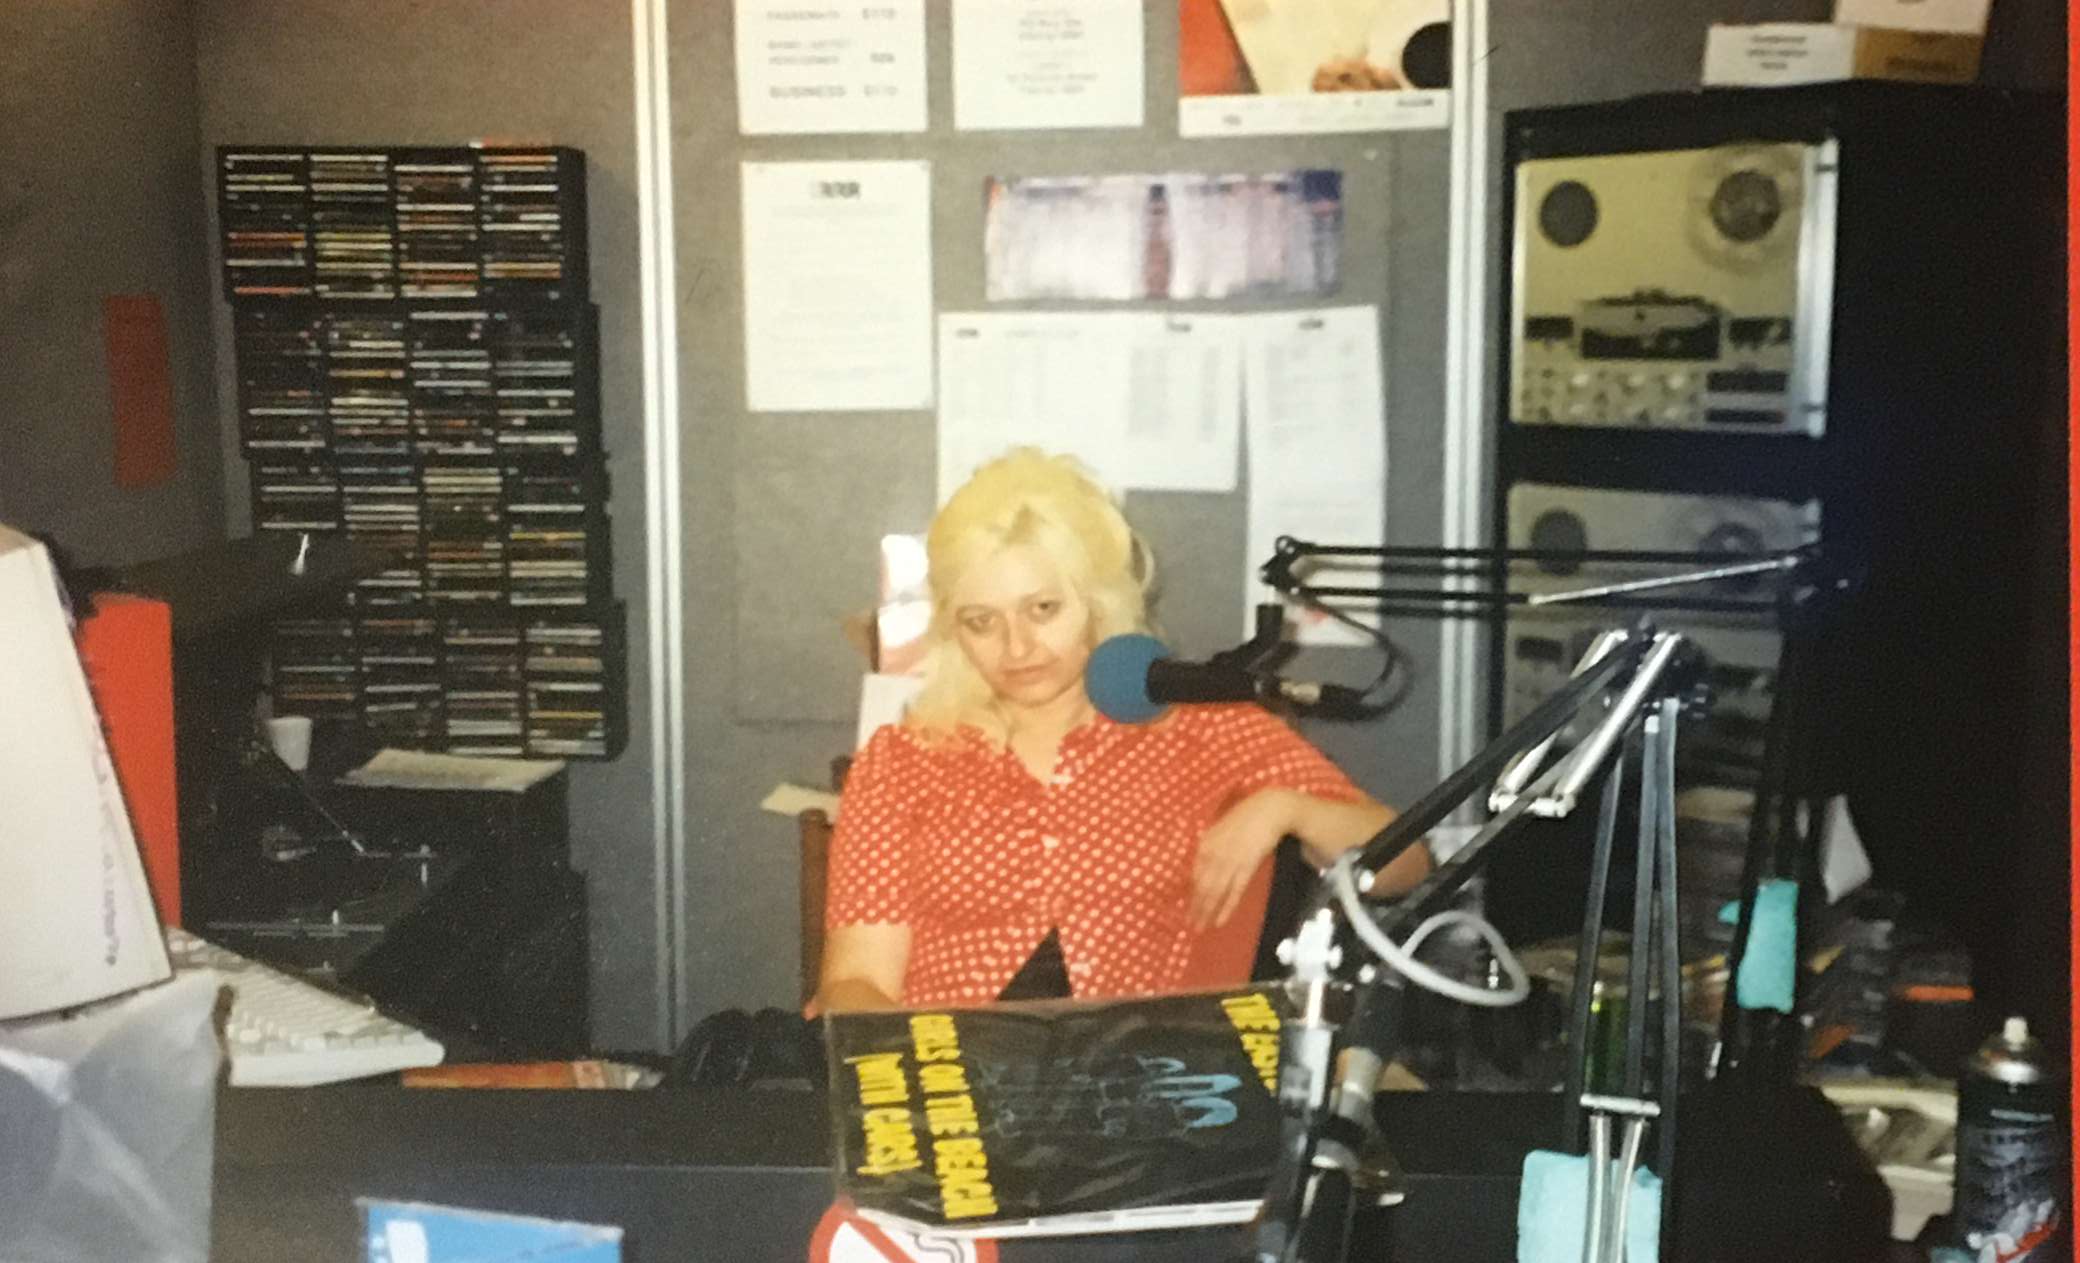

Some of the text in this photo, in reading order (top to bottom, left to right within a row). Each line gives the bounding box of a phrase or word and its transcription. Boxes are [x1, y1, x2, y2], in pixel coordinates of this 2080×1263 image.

[1221, 993, 1280, 1031] THE
[856, 1107, 922, 1175] CARS)
[910, 1014, 998, 1219] GIRLS ON THE BEACH
